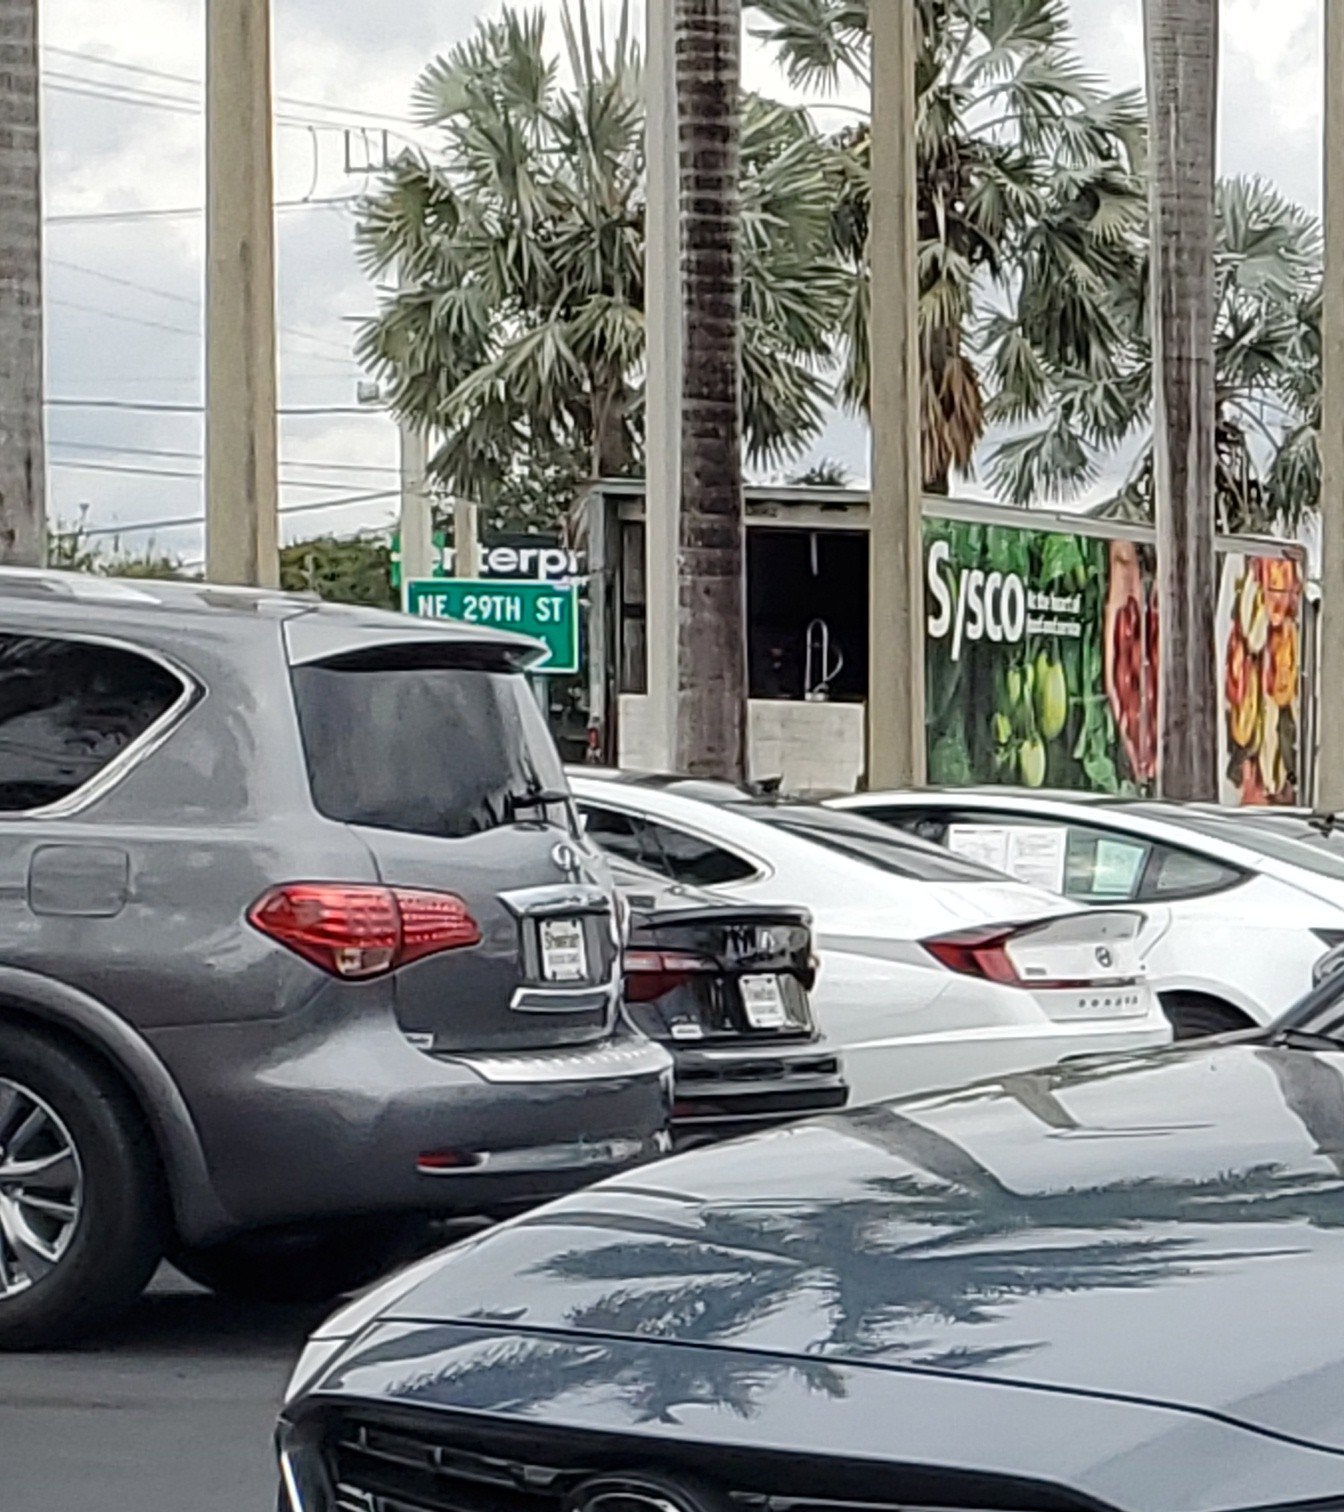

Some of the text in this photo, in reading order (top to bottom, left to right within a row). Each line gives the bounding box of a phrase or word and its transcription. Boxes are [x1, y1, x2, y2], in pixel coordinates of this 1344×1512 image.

[418, 594, 563, 622] NE 29TH ST
